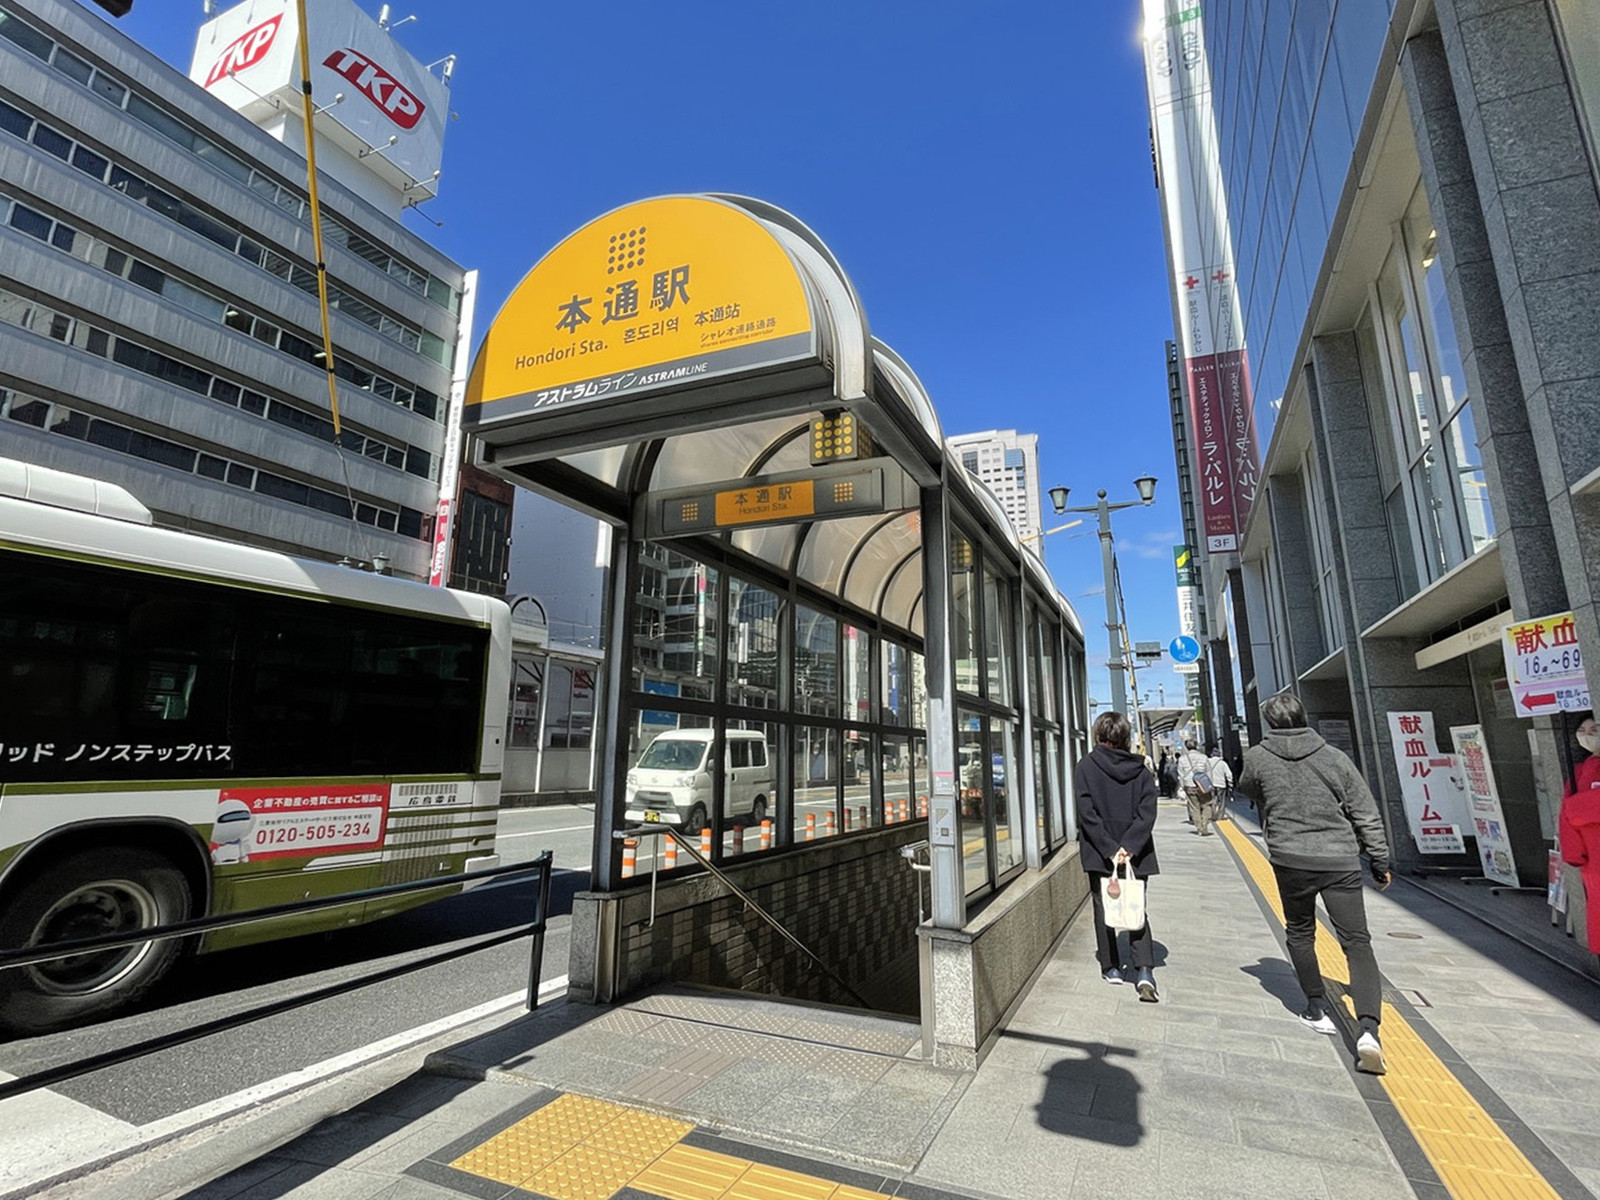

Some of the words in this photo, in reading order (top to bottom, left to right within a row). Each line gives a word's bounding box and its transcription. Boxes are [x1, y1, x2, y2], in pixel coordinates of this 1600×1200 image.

[211, 22, 277, 81] TKP
[335, 53, 418, 117] TKP
[555, 264, 690, 334] 本通駅
[694, 302, 741, 327] 本通站
[623, 317, 679, 344] 혼도리역
[515, 343, 576, 370] Hondori
[579, 338, 609, 355] Sta.
[534, 372, 638, 408] アストラムライン
[638, 361, 708, 385] ASTRAMLINE
[1199, 377, 1213, 438] エステティックサロン
[1203, 441, 1224, 505] ラ・パルレ
[735, 485, 792, 507] 本通駅
[739, 504, 771, 515] Hondori
[772, 502, 789, 511] Sta.
[1214, 539, 1230, 548] 3F
[1182, 590, 1196, 637] 三井住友
[1514, 617, 1578, 656] 献血
[65, 743, 231, 762] ノンステップバス
[1398, 715, 1442, 821] 献血ルーム
[256, 822, 370, 845] 0120-505-234
